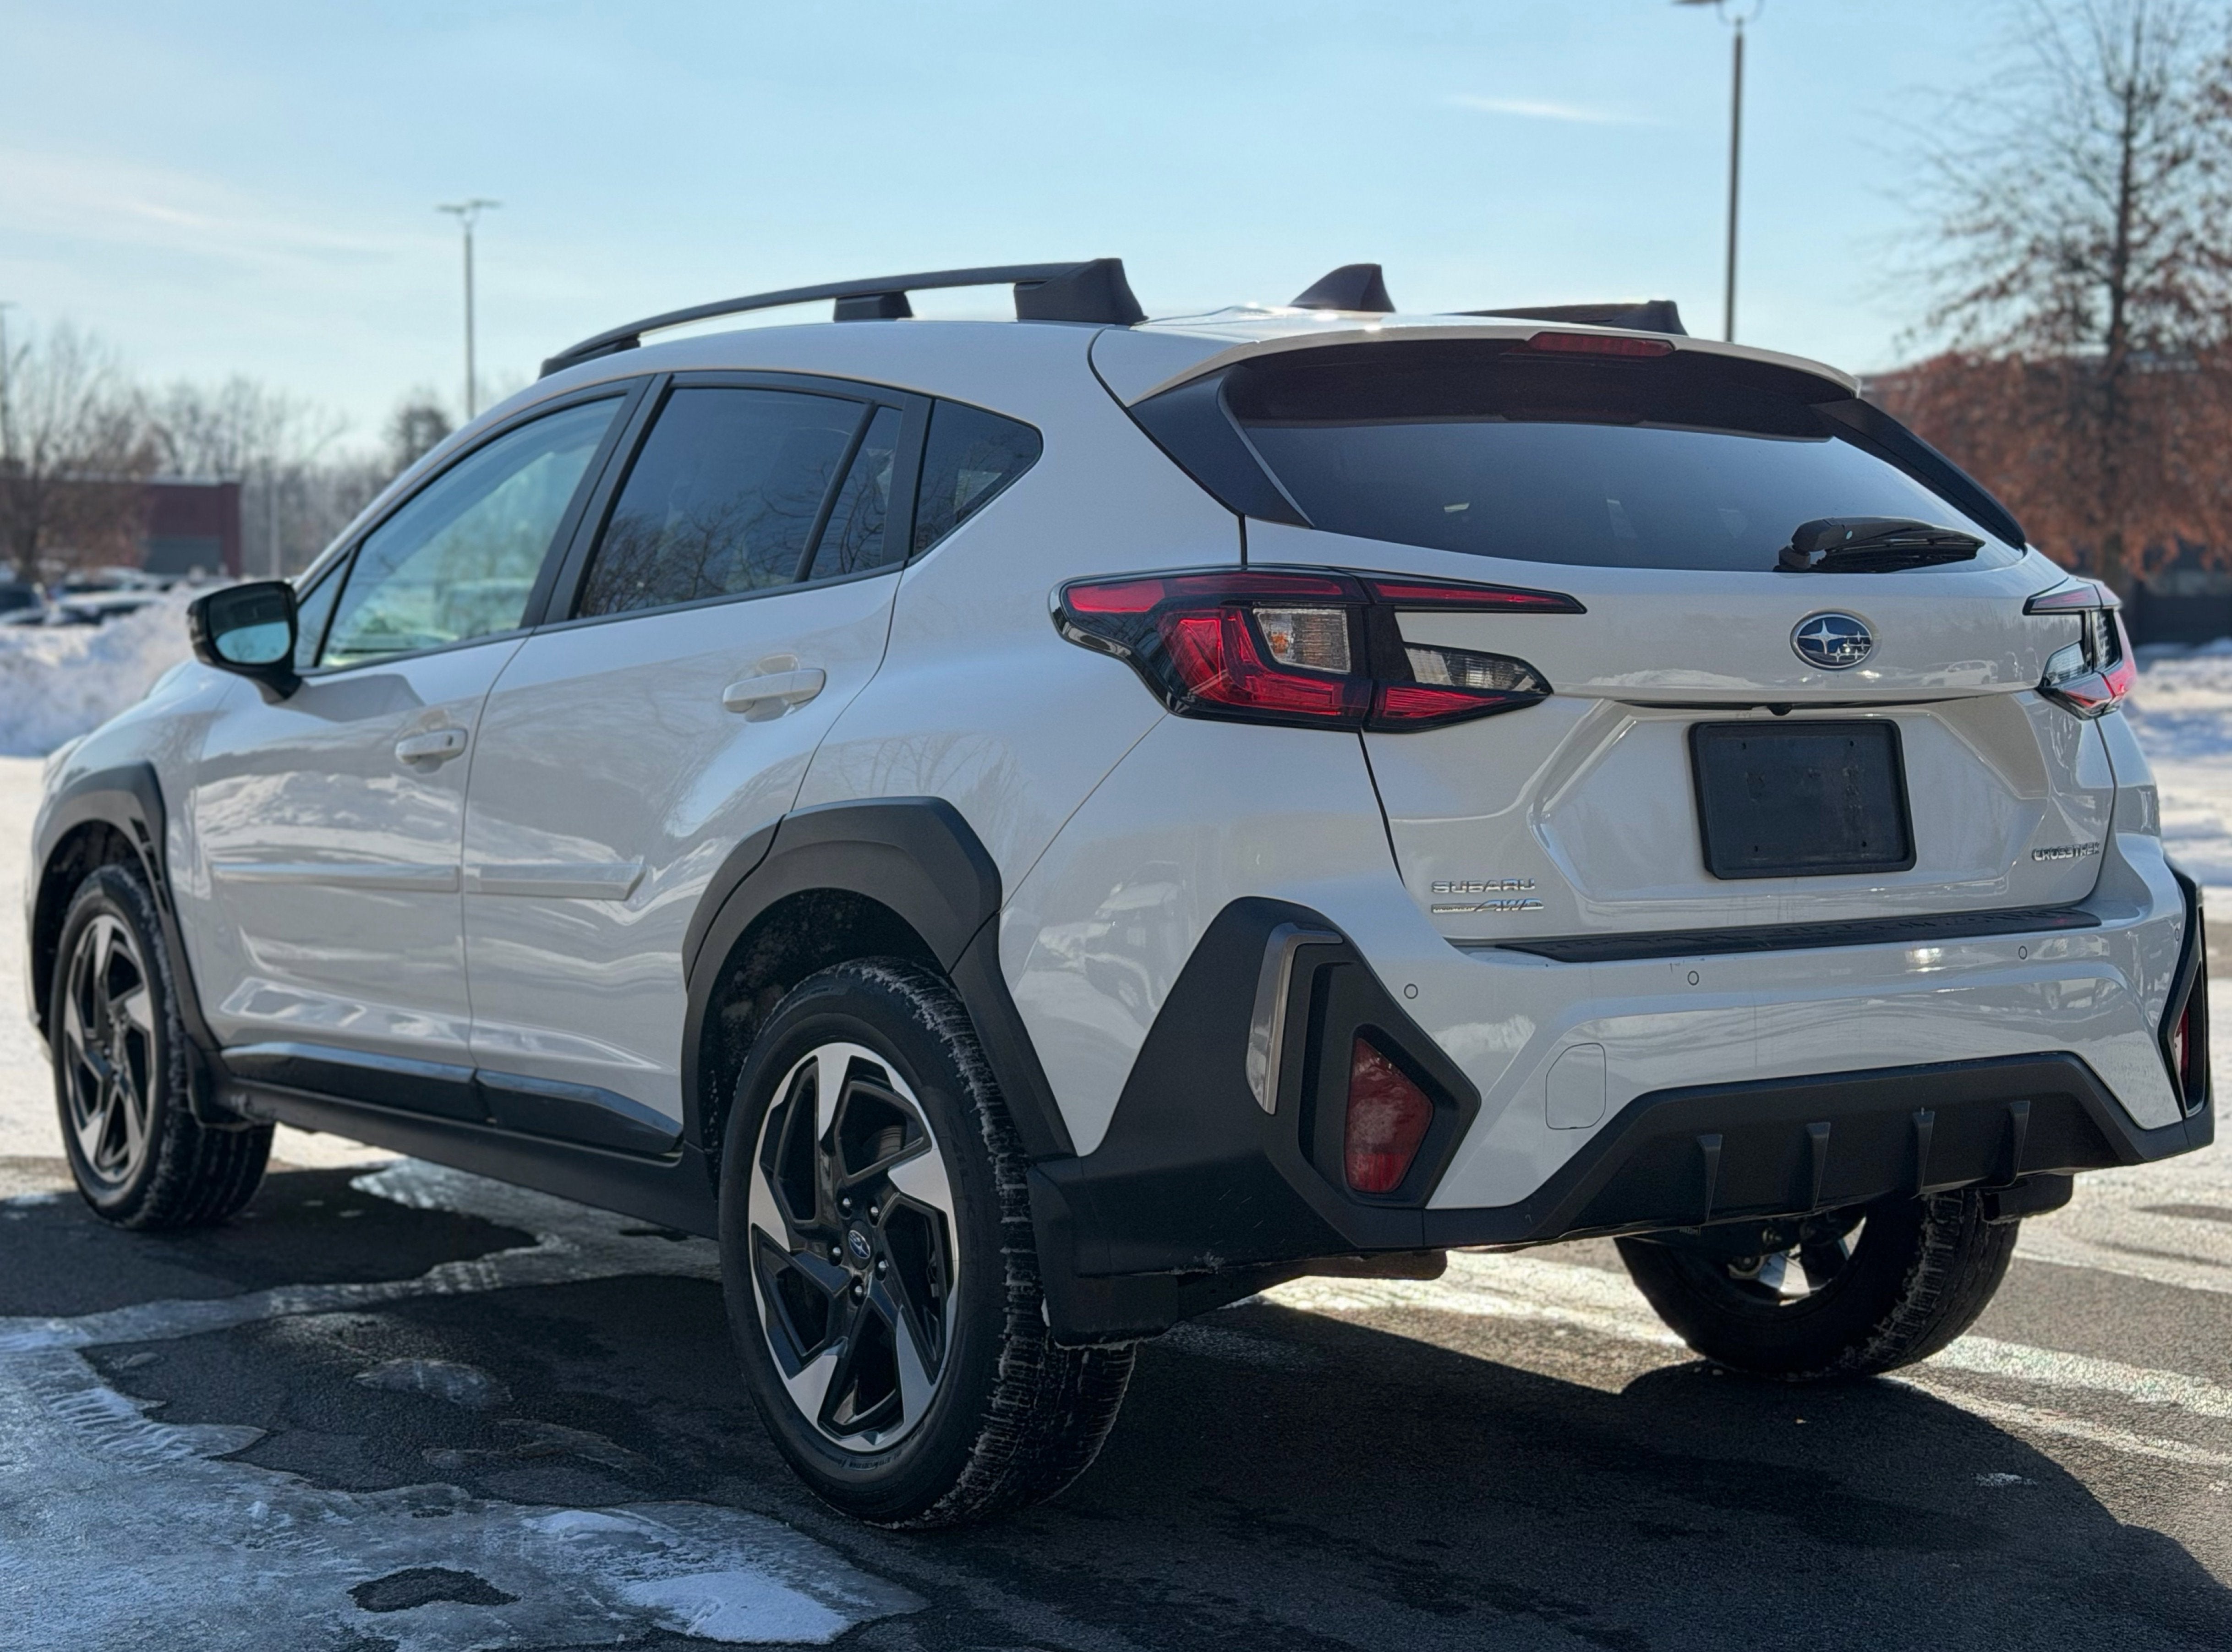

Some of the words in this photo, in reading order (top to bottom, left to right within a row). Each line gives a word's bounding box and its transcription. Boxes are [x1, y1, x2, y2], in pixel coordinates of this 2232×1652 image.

[2032, 842, 2100, 861] CROSSTREK
[1432, 878, 1535, 893] SUBARU
[1474, 899, 1544, 912] AWD
